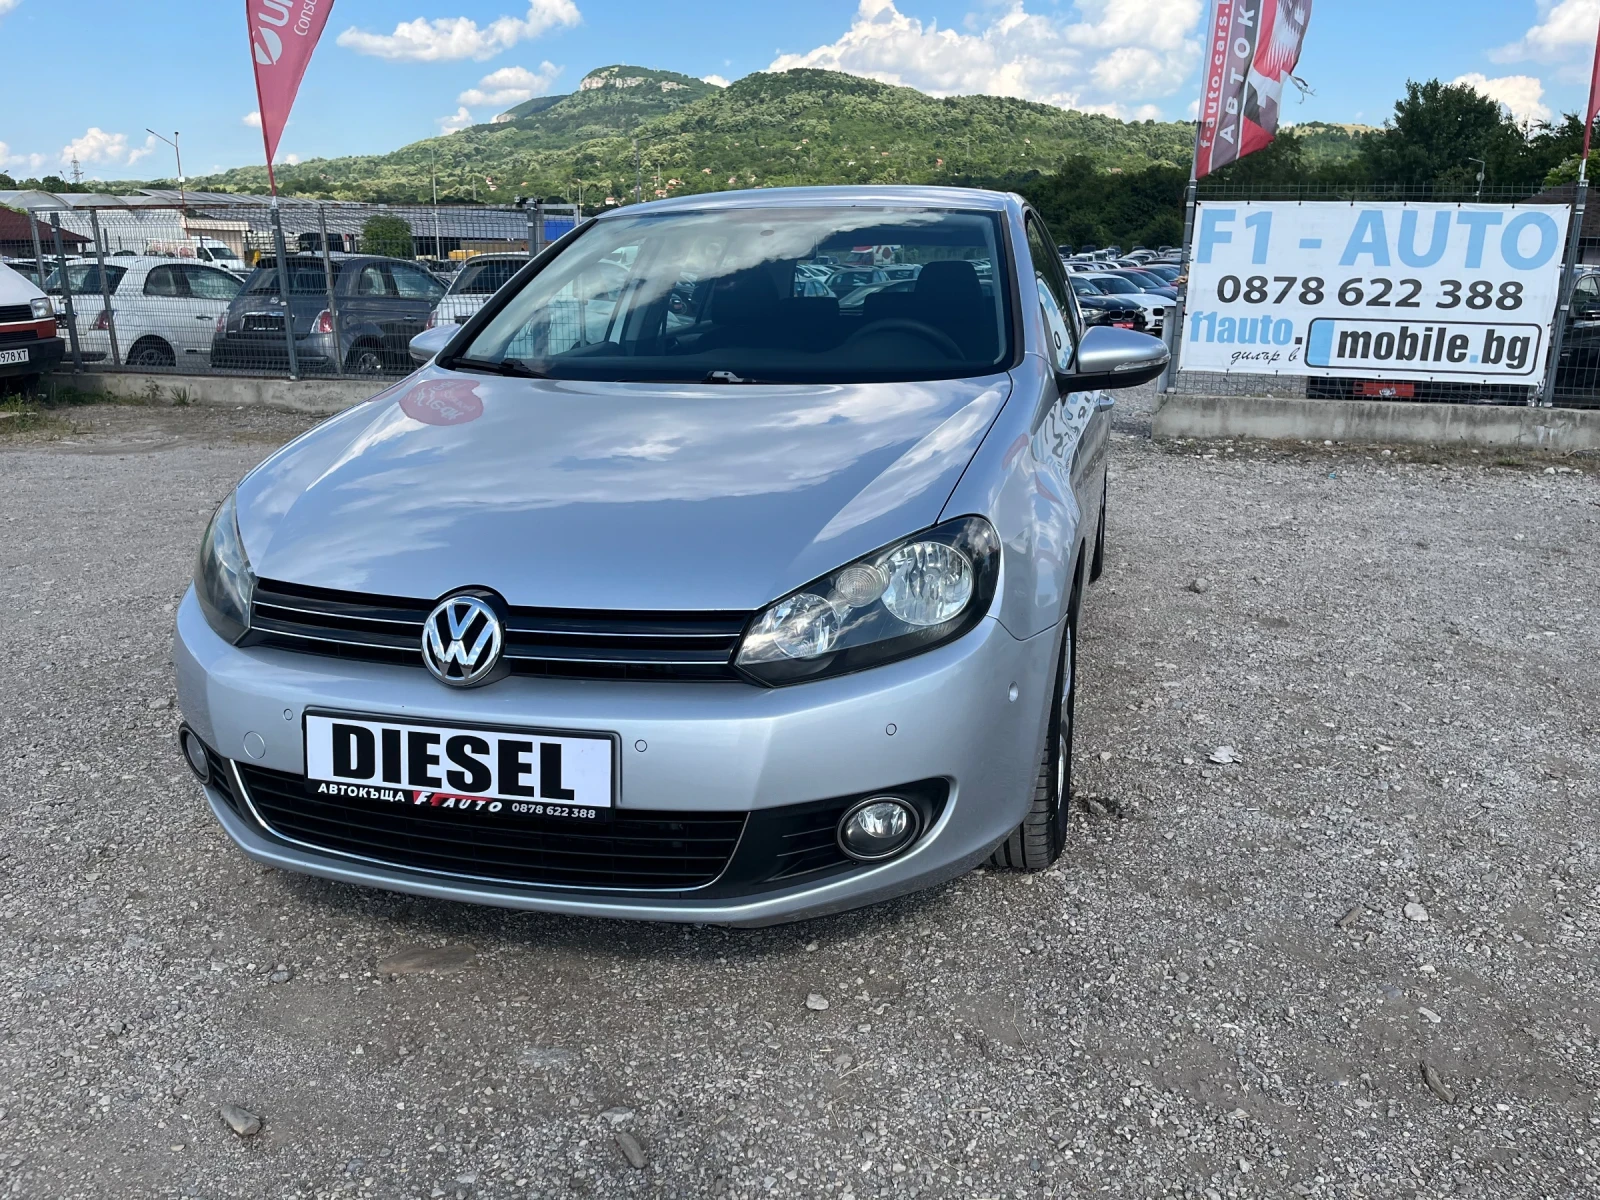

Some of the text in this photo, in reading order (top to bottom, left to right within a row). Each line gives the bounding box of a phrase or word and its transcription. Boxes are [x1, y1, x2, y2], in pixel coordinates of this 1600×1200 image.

[1196, 208, 1273, 265] F1
[1337, 209, 1559, 271] AUTO
[1216, 274, 1524, 311] 0878 622 388
[1336, 325, 1531, 370] mobile.bg
[426, 600, 496, 681] VW
[331, 722, 575, 801] DIESEL
[317, 782, 405, 802] АВТОКЪЩА
[511, 802, 544, 815] 0878
[546, 806, 569, 817] 622
[571, 808, 596, 819] 388
